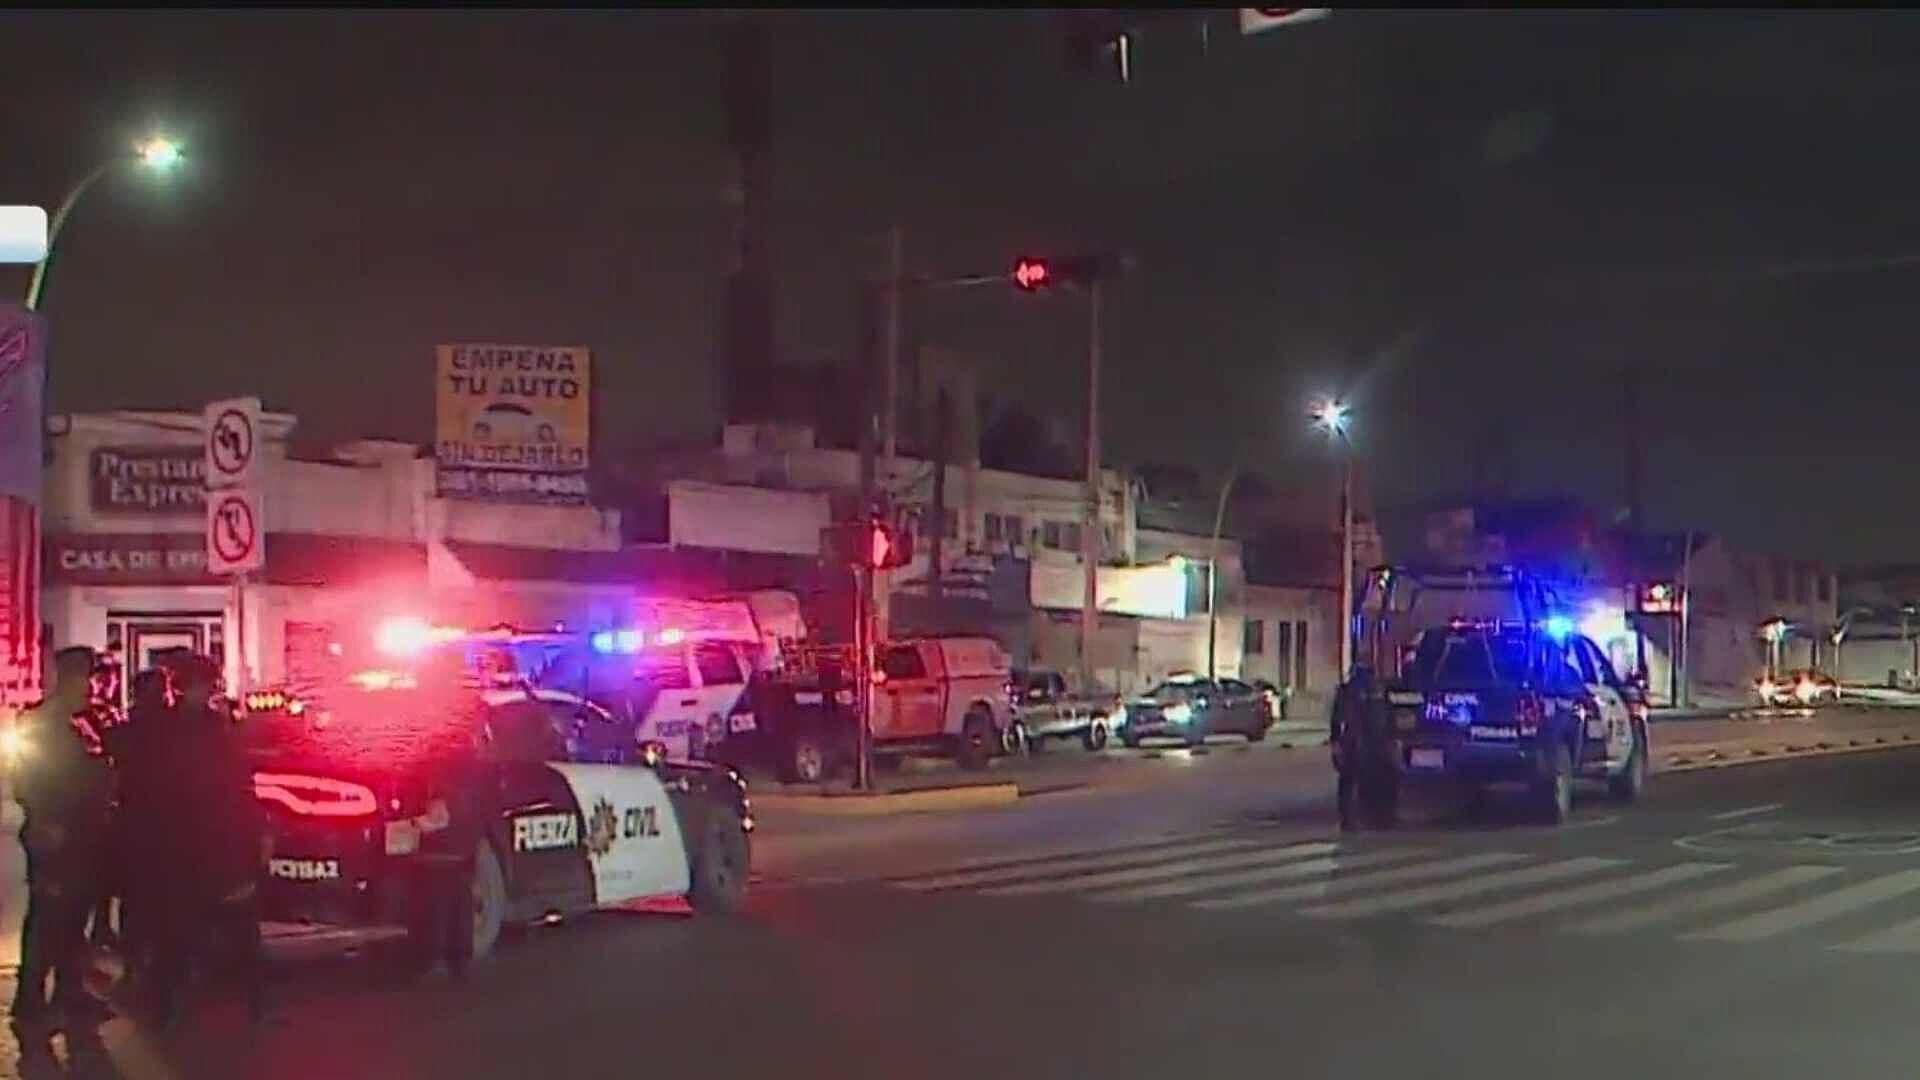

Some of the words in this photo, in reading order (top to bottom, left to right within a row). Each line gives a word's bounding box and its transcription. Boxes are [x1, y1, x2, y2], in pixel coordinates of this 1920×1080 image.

[450, 376, 486, 395] TU
[500, 377, 579, 399] AUTO
[61, 549, 123, 570] CASA
[128, 551, 160, 570] DE
[514, 814, 577, 851] FUERZA
[623, 804, 661, 838] CIVIL
